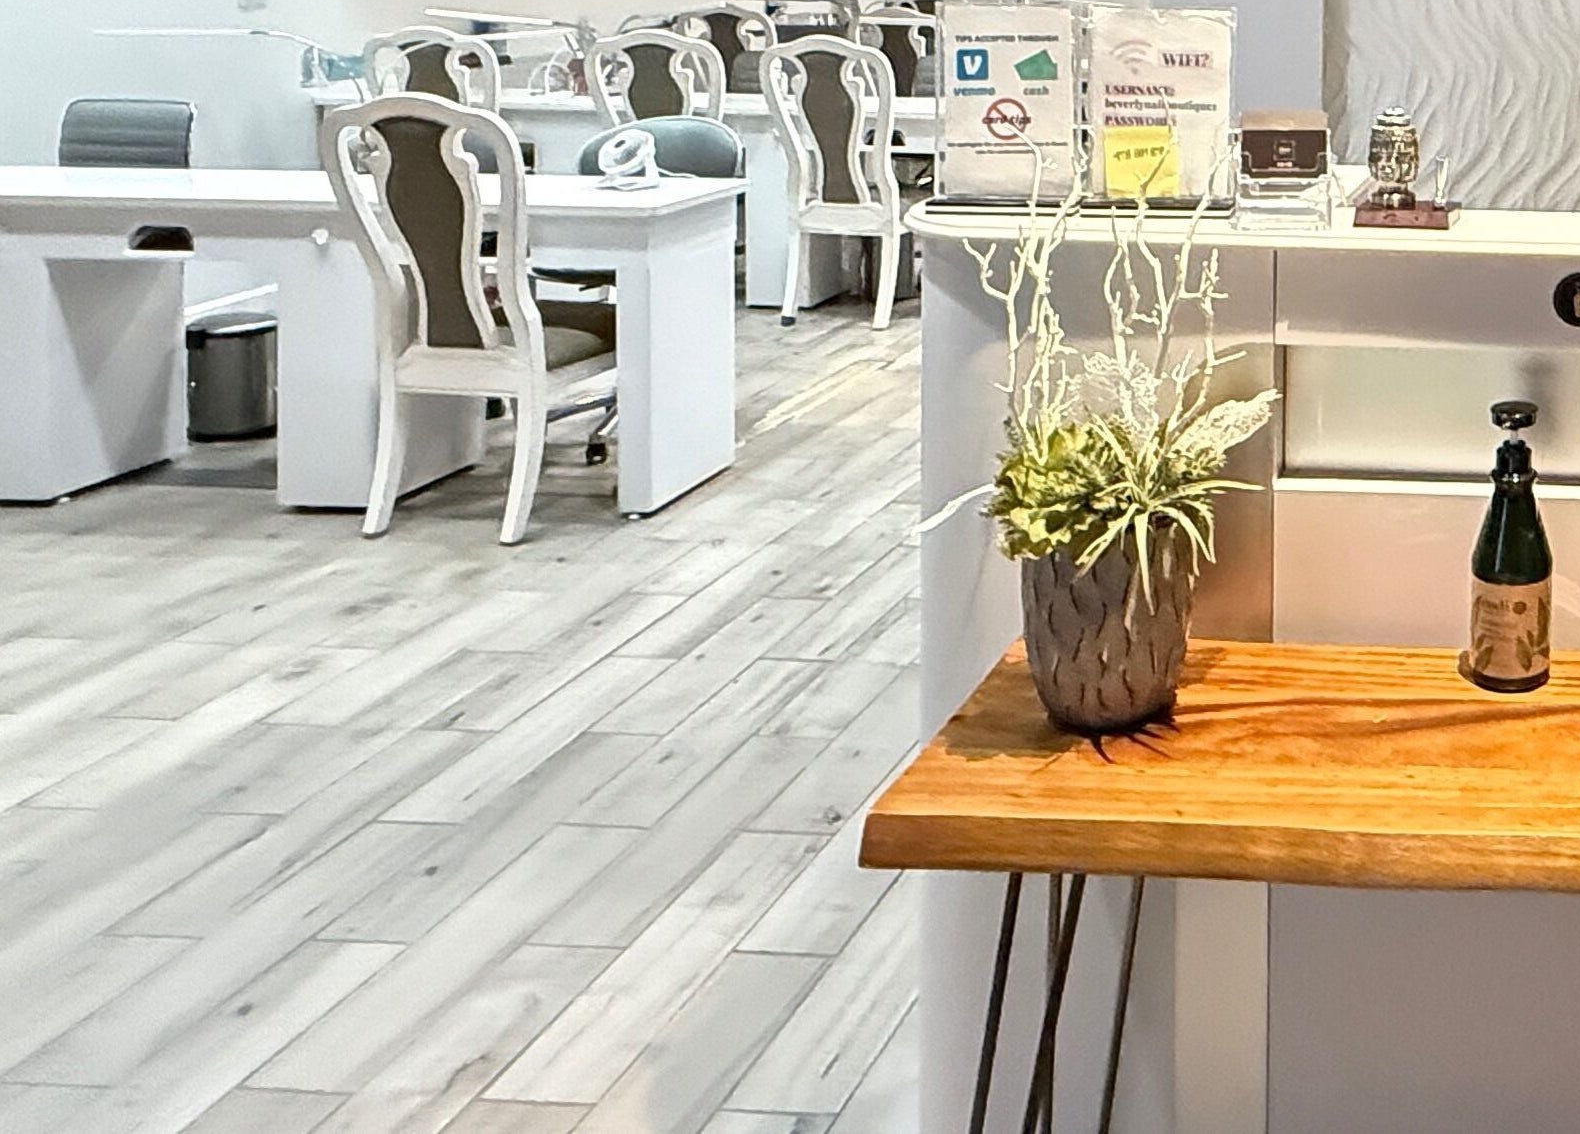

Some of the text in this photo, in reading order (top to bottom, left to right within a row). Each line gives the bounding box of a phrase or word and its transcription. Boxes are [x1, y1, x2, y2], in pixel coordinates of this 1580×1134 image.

[955, 34, 973, 43] TIPS
[974, 34, 1016, 43] ACCEPTED
[953, 87, 996, 97] venmo
[1022, 85, 1050, 96] cash
